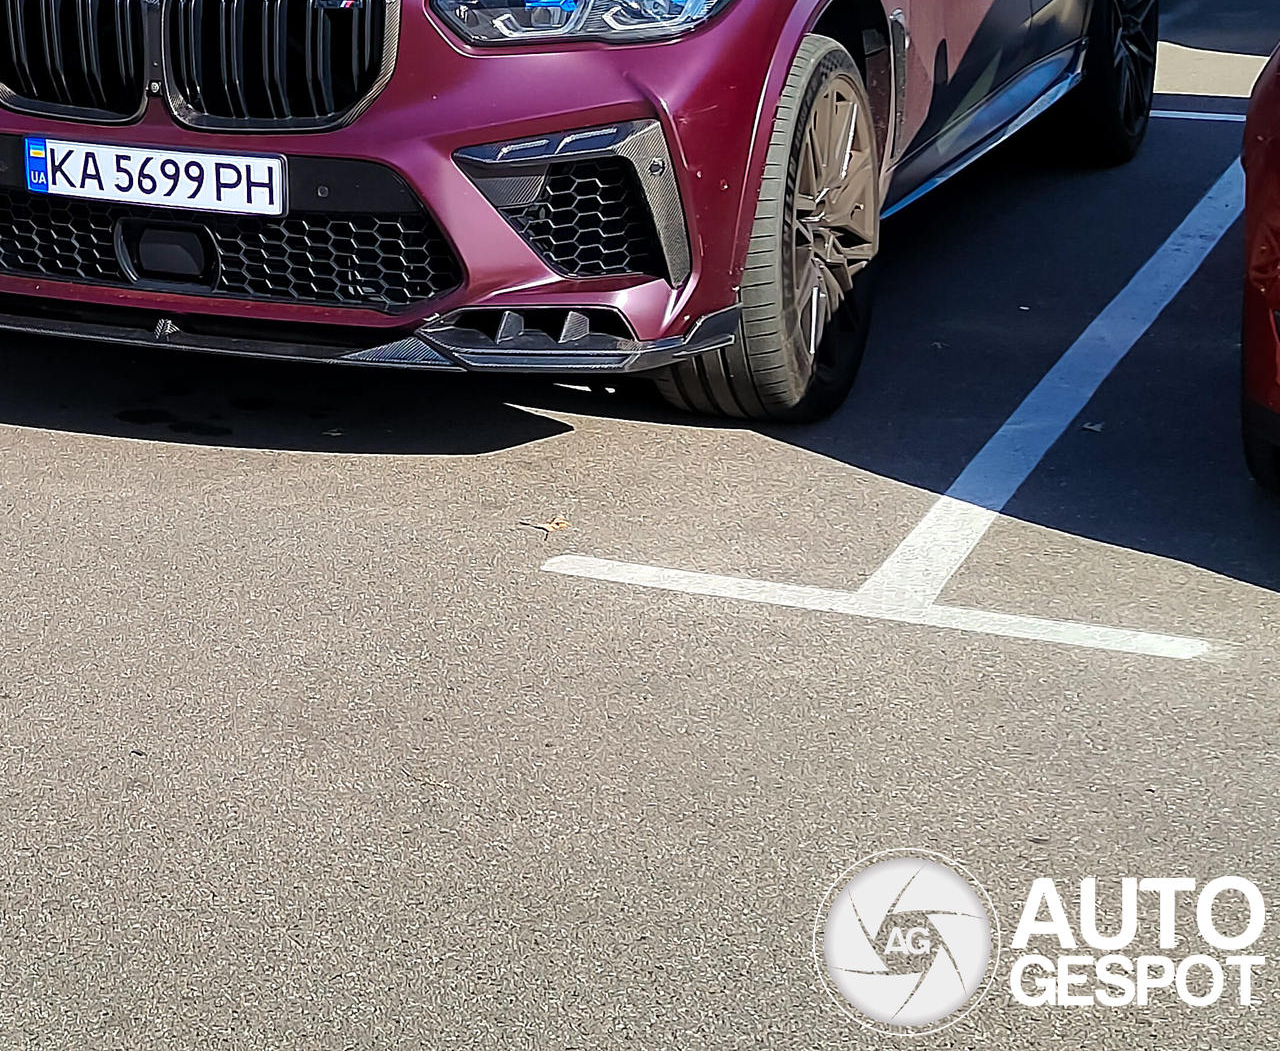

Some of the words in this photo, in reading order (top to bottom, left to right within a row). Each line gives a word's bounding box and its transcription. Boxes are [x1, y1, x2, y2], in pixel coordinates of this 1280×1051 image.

[30, 170, 47, 185] UA
[49, 148, 105, 191] KA
[114, 154, 205, 199] 5699
[214, 162, 275, 206] PH
